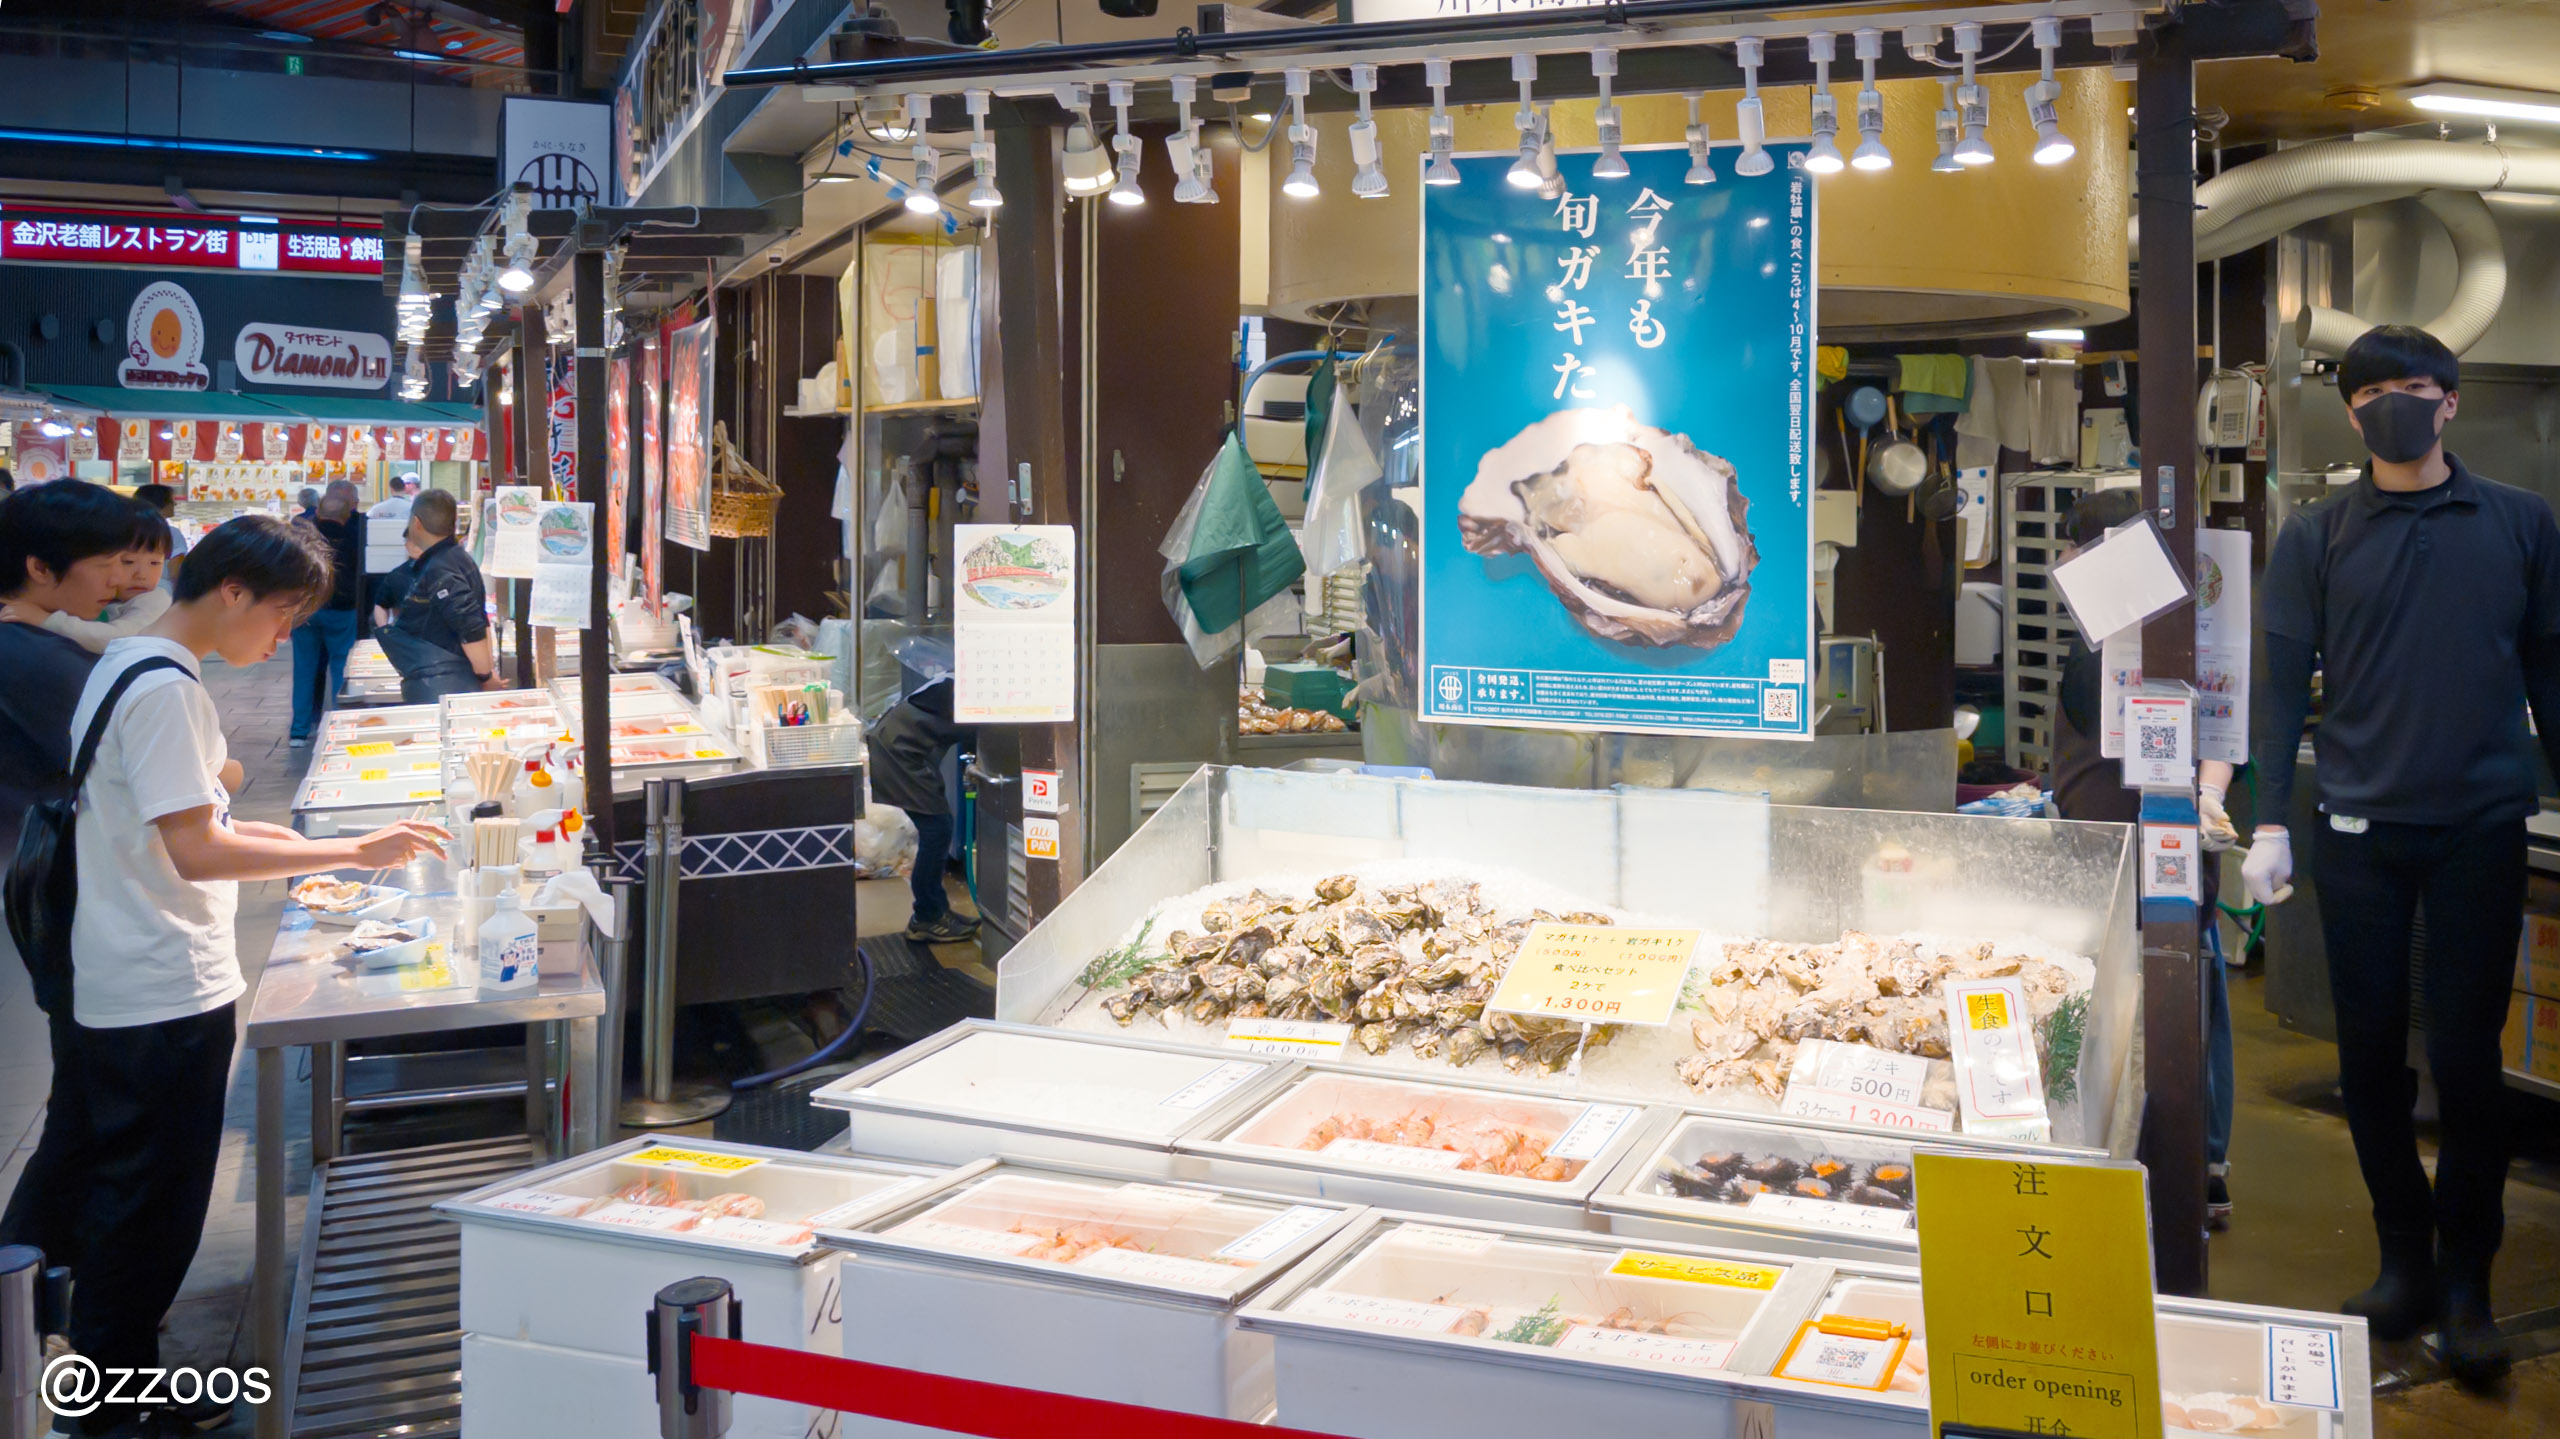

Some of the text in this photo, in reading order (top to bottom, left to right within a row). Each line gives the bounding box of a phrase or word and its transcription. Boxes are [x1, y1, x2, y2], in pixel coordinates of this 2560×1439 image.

[12, 221, 228, 254] 金沢老舗レストラン街
[1624, 186, 1675, 349] 今年も
[1551, 190, 1601, 401] 旬ガキた
[283, 331, 344, 348] ダイヤモンド
[244, 332, 360, 378] Diamond
[1029, 826, 1052, 838] au
[1030, 839, 1053, 852] PAY
[1551, 963, 1639, 977] 食べ比べセット
[1257, 1024, 1321, 1038] 岩ガキ
[1850, 1076, 1911, 1103] 500円
[2012, 1162, 2054, 1318] 注文口
[1638, 1259, 1760, 1282] サービス品
[1588, 1330, 1719, 1352] 生ボタンエビ
[1971, 1332, 2116, 1362] 左側にお並びください
[2307, 1332, 2326, 1368] その場で
[1969, 1368, 2123, 1408] order opening
